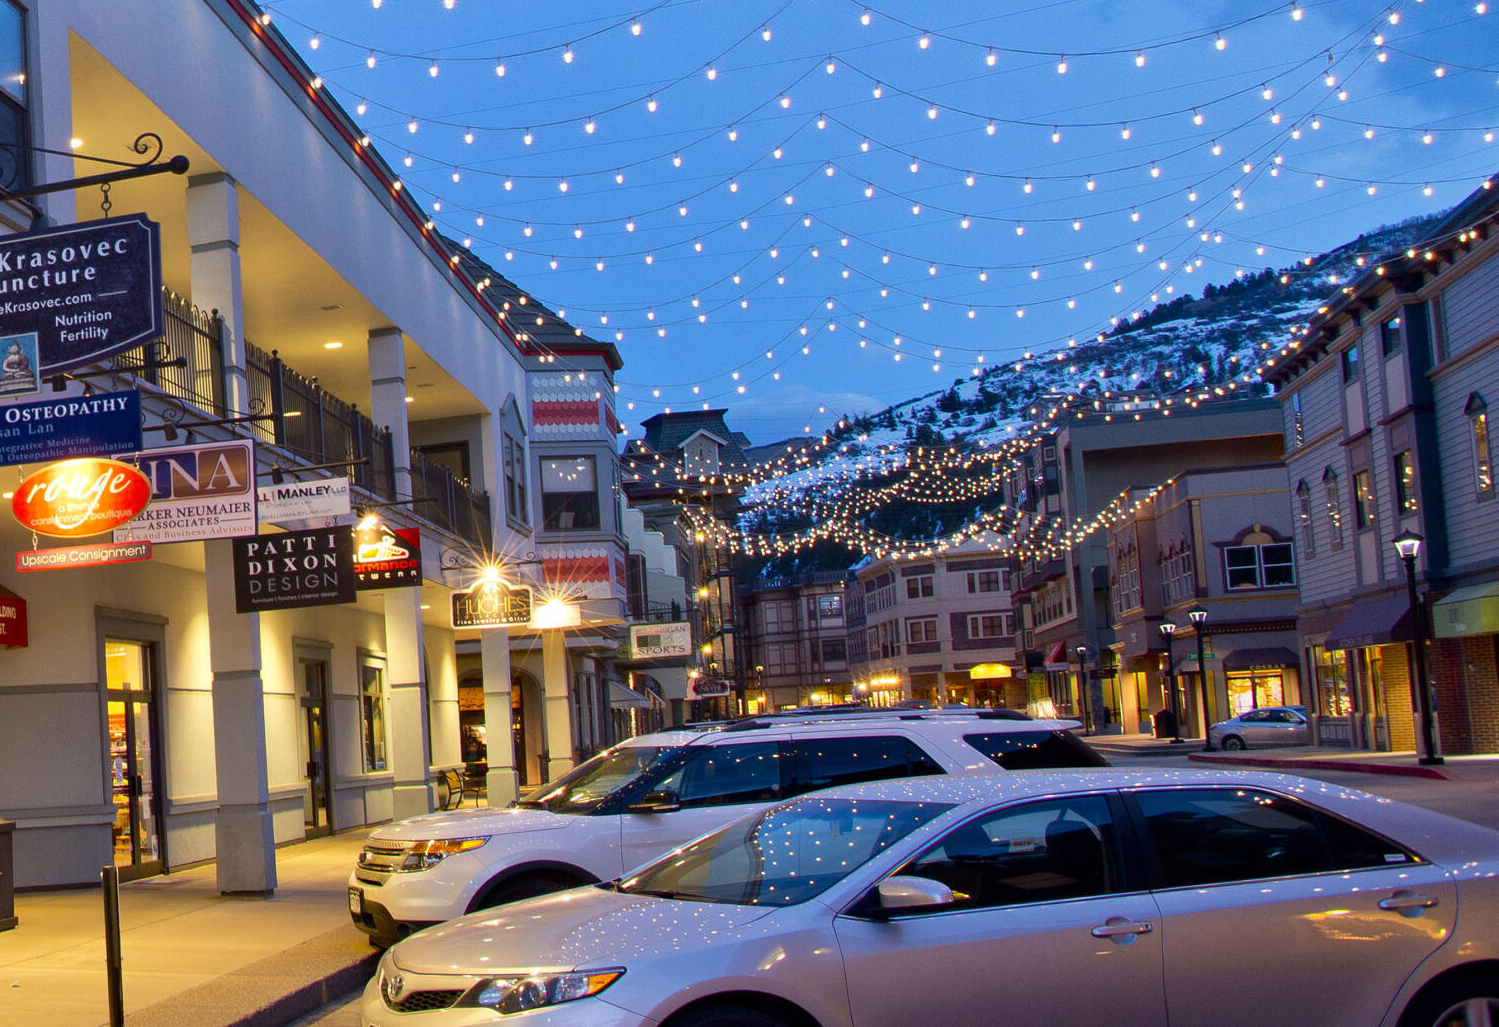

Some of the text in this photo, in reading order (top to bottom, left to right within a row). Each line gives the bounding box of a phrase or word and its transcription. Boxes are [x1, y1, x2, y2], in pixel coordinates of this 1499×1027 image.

[55, 310, 112, 327] Nutrition
[60, 327, 109, 343] Fertility
[5, 397, 129, 423] OSTEOPATHY
[28, 423, 54, 434] Lan
[47, 437, 91, 448] Medicine
[7, 449, 64, 462] Osteopathic
[68, 442, 134, 454] Manipulation
[26, 468, 131, 529] rouge
[278, 485, 330, 500] MANLEY
[132, 509, 174, 521] RKER
[177, 502, 251, 518] NEUMAIER
[145, 531, 162, 539] and
[164, 529, 205, 538] Business
[210, 525, 252, 535] Advisors
[148, 516, 219, 530] ASSOCIATES
[247, 534, 336, 556] PATTI
[21, 543, 147, 567] Upscale Consignment
[248, 553, 337, 576] DIXON
[250, 573, 338, 594] DESIGN
[457, 596, 526, 614] HUGHES
[638, 645, 685, 655] SPORTS
